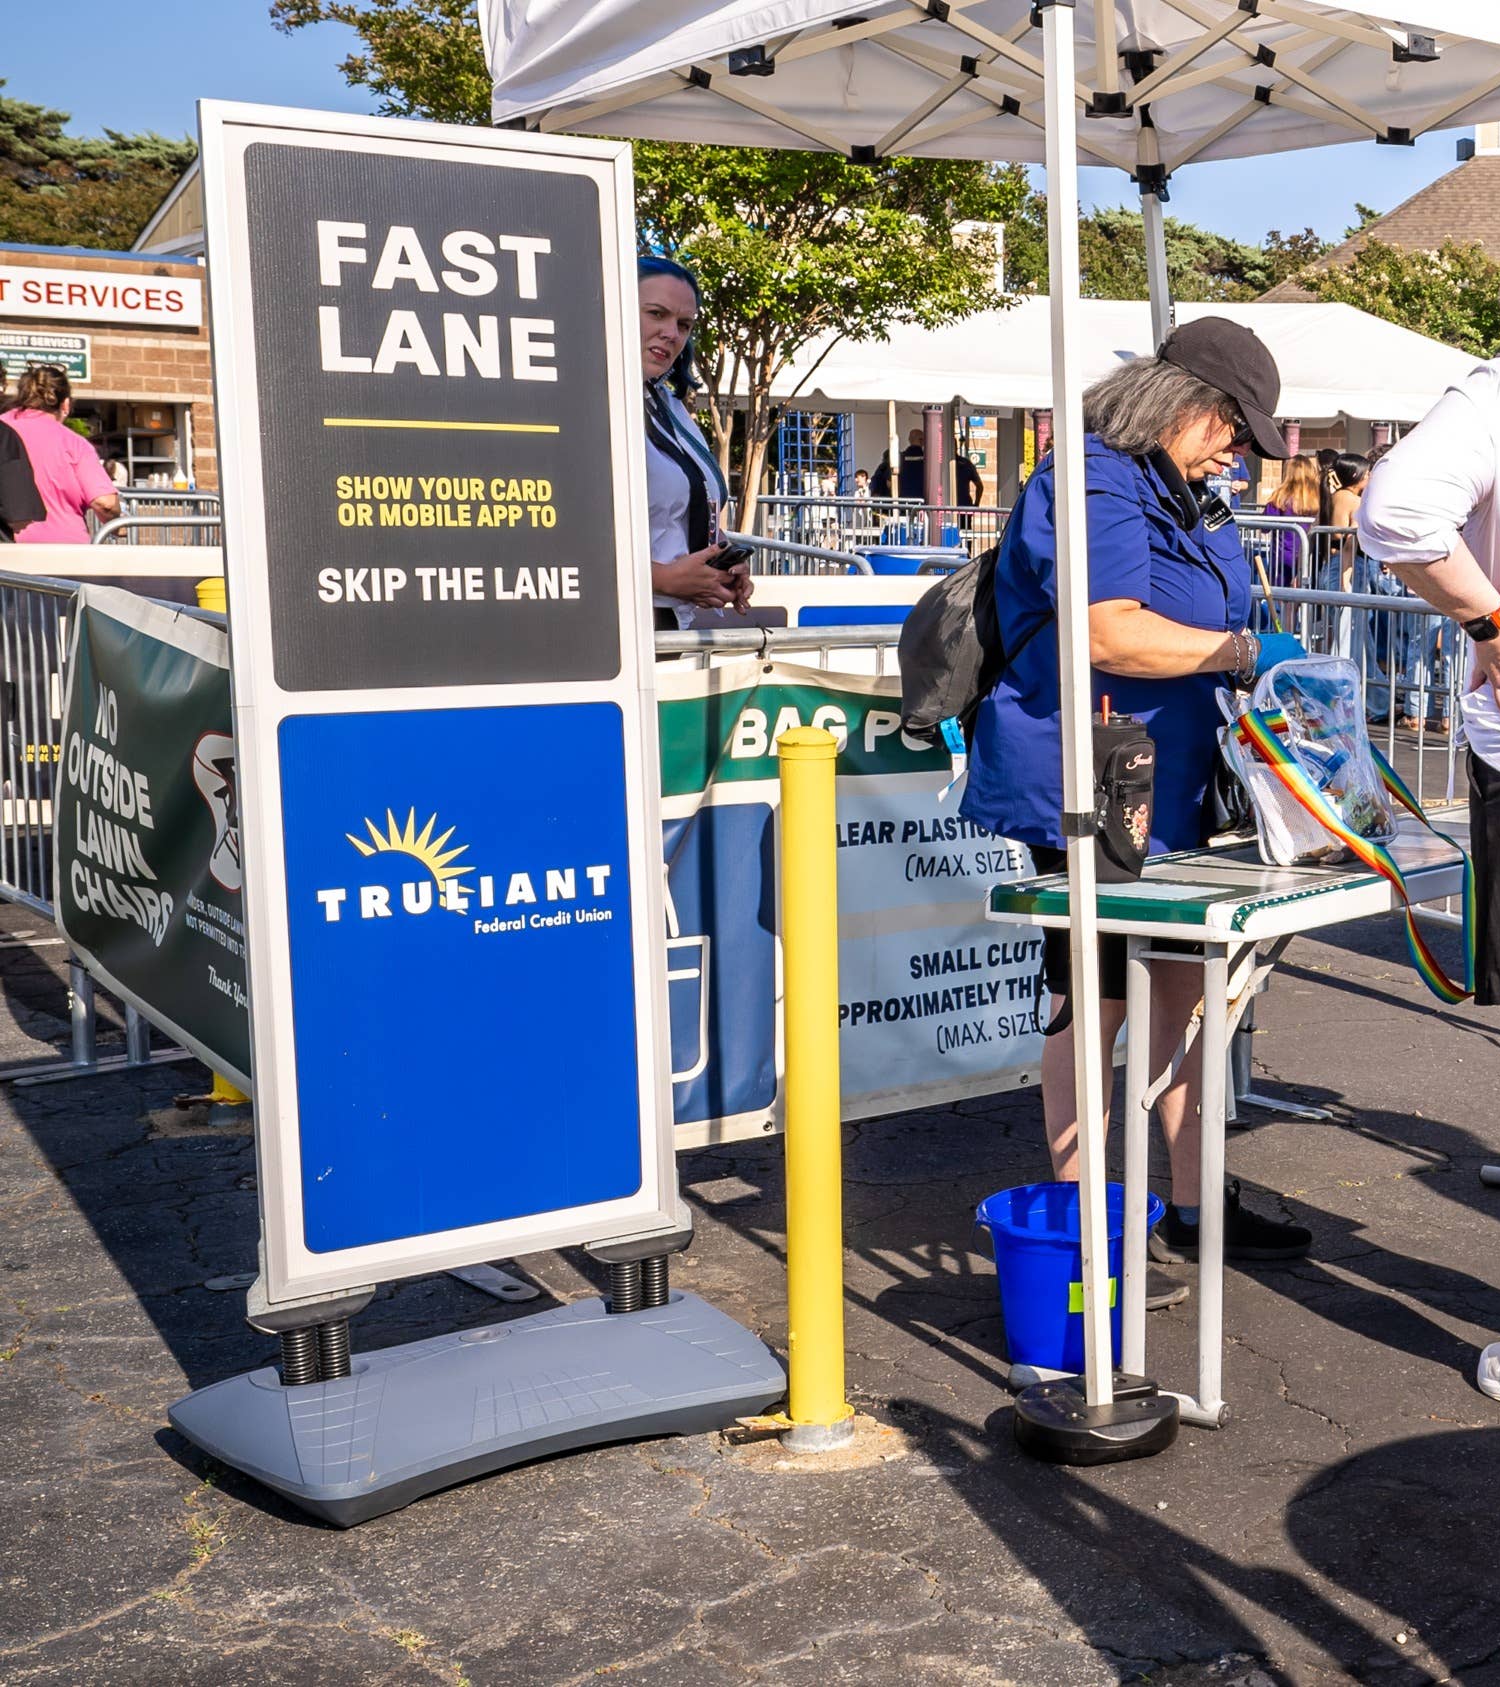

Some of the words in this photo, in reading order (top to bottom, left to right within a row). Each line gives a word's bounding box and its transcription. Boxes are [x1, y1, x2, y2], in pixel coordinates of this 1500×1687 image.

[317, 220, 551, 299] FAST
[22, 280, 184, 312] SERVICES
[30, 336, 82, 349] SERVICES
[318, 305, 558, 382] LANE
[336, 475, 412, 500] SHOW
[418, 477, 485, 501] YOUR
[490, 479, 552, 502] CARD
[338, 503, 373, 527] OR
[379, 503, 471, 527] MOBILE
[477, 505, 523, 528] APP
[527, 505, 557, 528] TO
[318, 567, 408, 603] SKIP
[415, 567, 485, 601] THE
[494, 566, 581, 600] LANE
[94, 681, 119, 747] NO
[68, 731, 155, 830] OUTSIDE
[76, 801, 158, 880] LAWN
[905, 853, 971, 881] (MAX.
[975, 849, 1024, 875] SIZE:
[70, 859, 175, 948] CHAIRS
[316, 864, 612, 922] TRULIANT
[207, 903, 231, 928] OUTSIDE
[474, 914, 526, 935] Federal
[530, 911, 572, 929] Credit
[575, 908, 613, 923] Union
[186, 912, 198, 931] NOT
[198, 919, 227, 947] PERMITTED
[226, 935, 239, 956] INTO
[208, 964, 232, 998] Thank
[910, 947, 982, 979] SMALL
[838, 980, 1001, 1028] PPROXIMATELY
[936, 1020, 992, 1055] (MAX.
